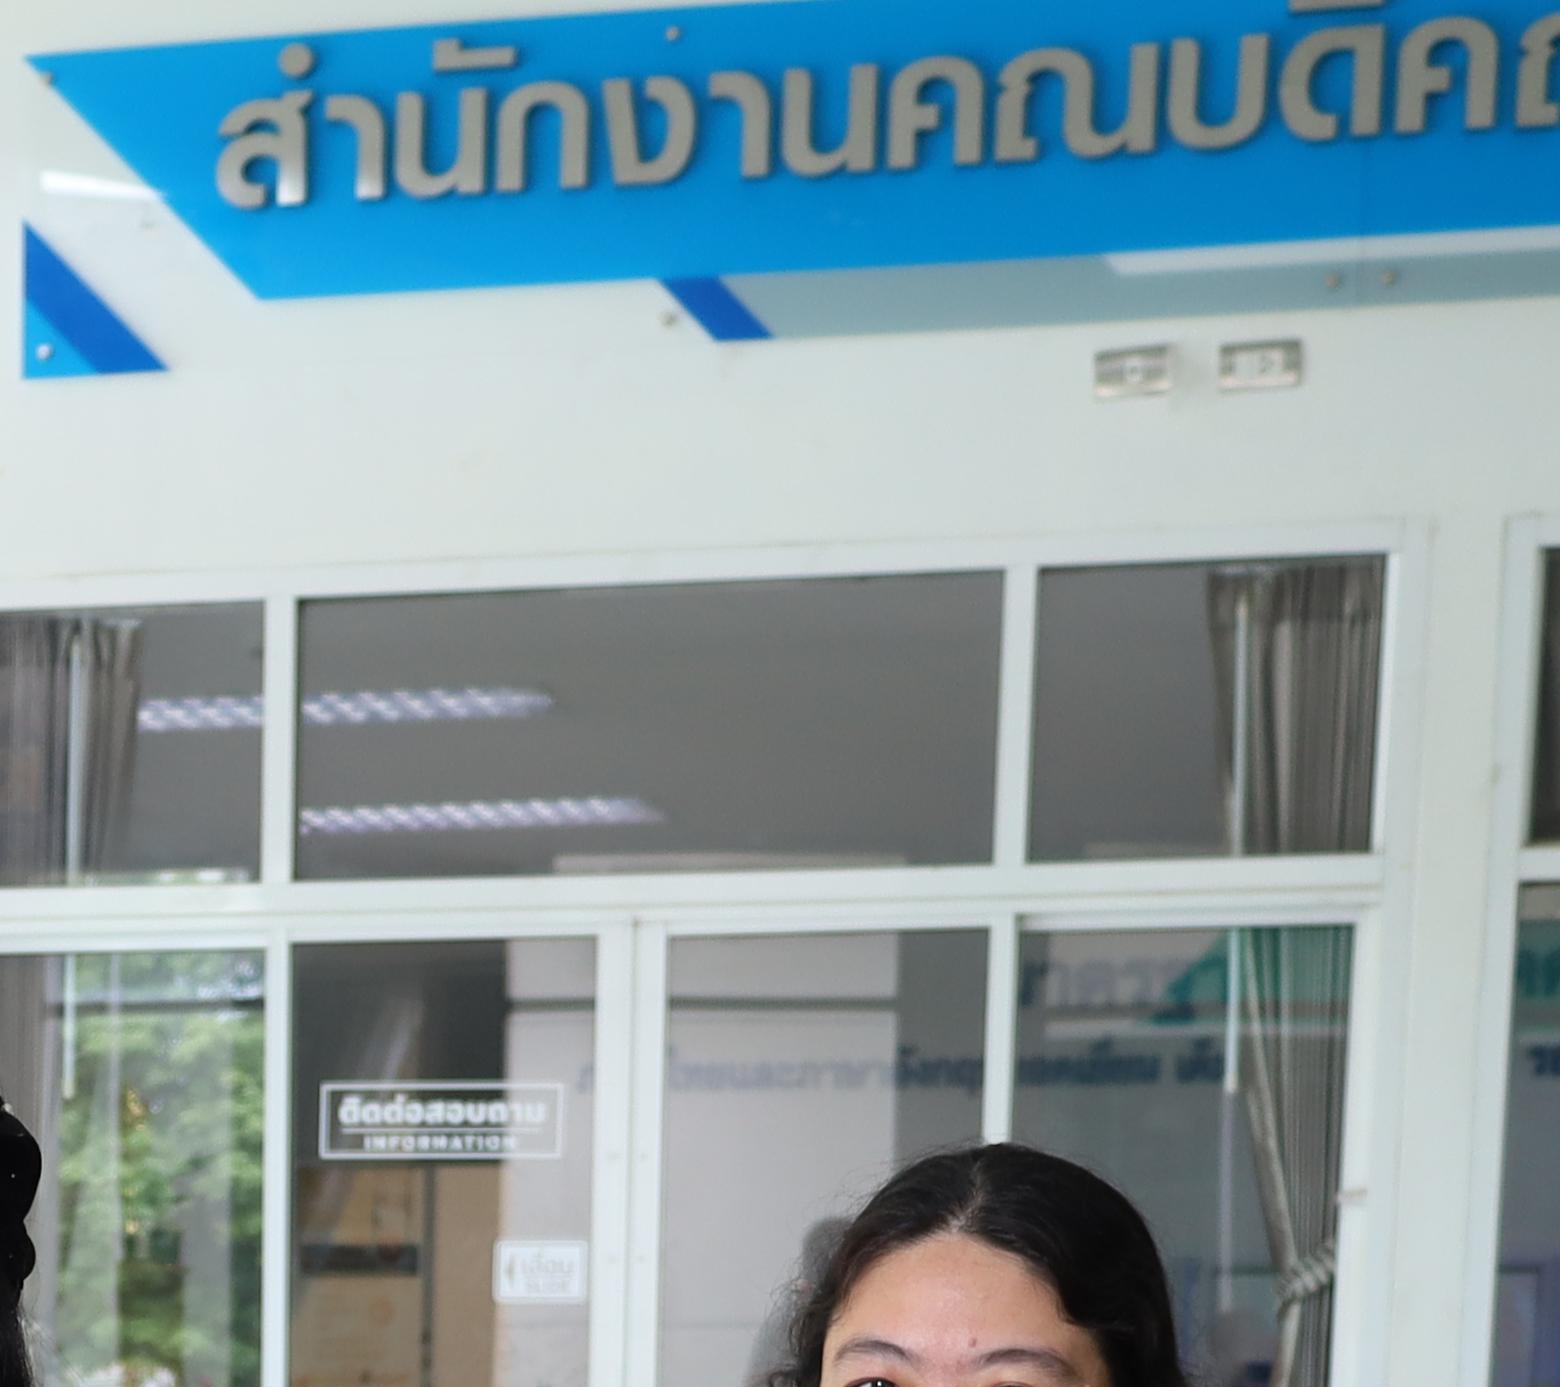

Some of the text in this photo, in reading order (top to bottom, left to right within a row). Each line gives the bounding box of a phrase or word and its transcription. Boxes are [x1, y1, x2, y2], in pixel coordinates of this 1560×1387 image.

[337, 1093, 547, 1125] ติดต่อสอบถาม
[362, 1134, 518, 1152] INFORMATION
